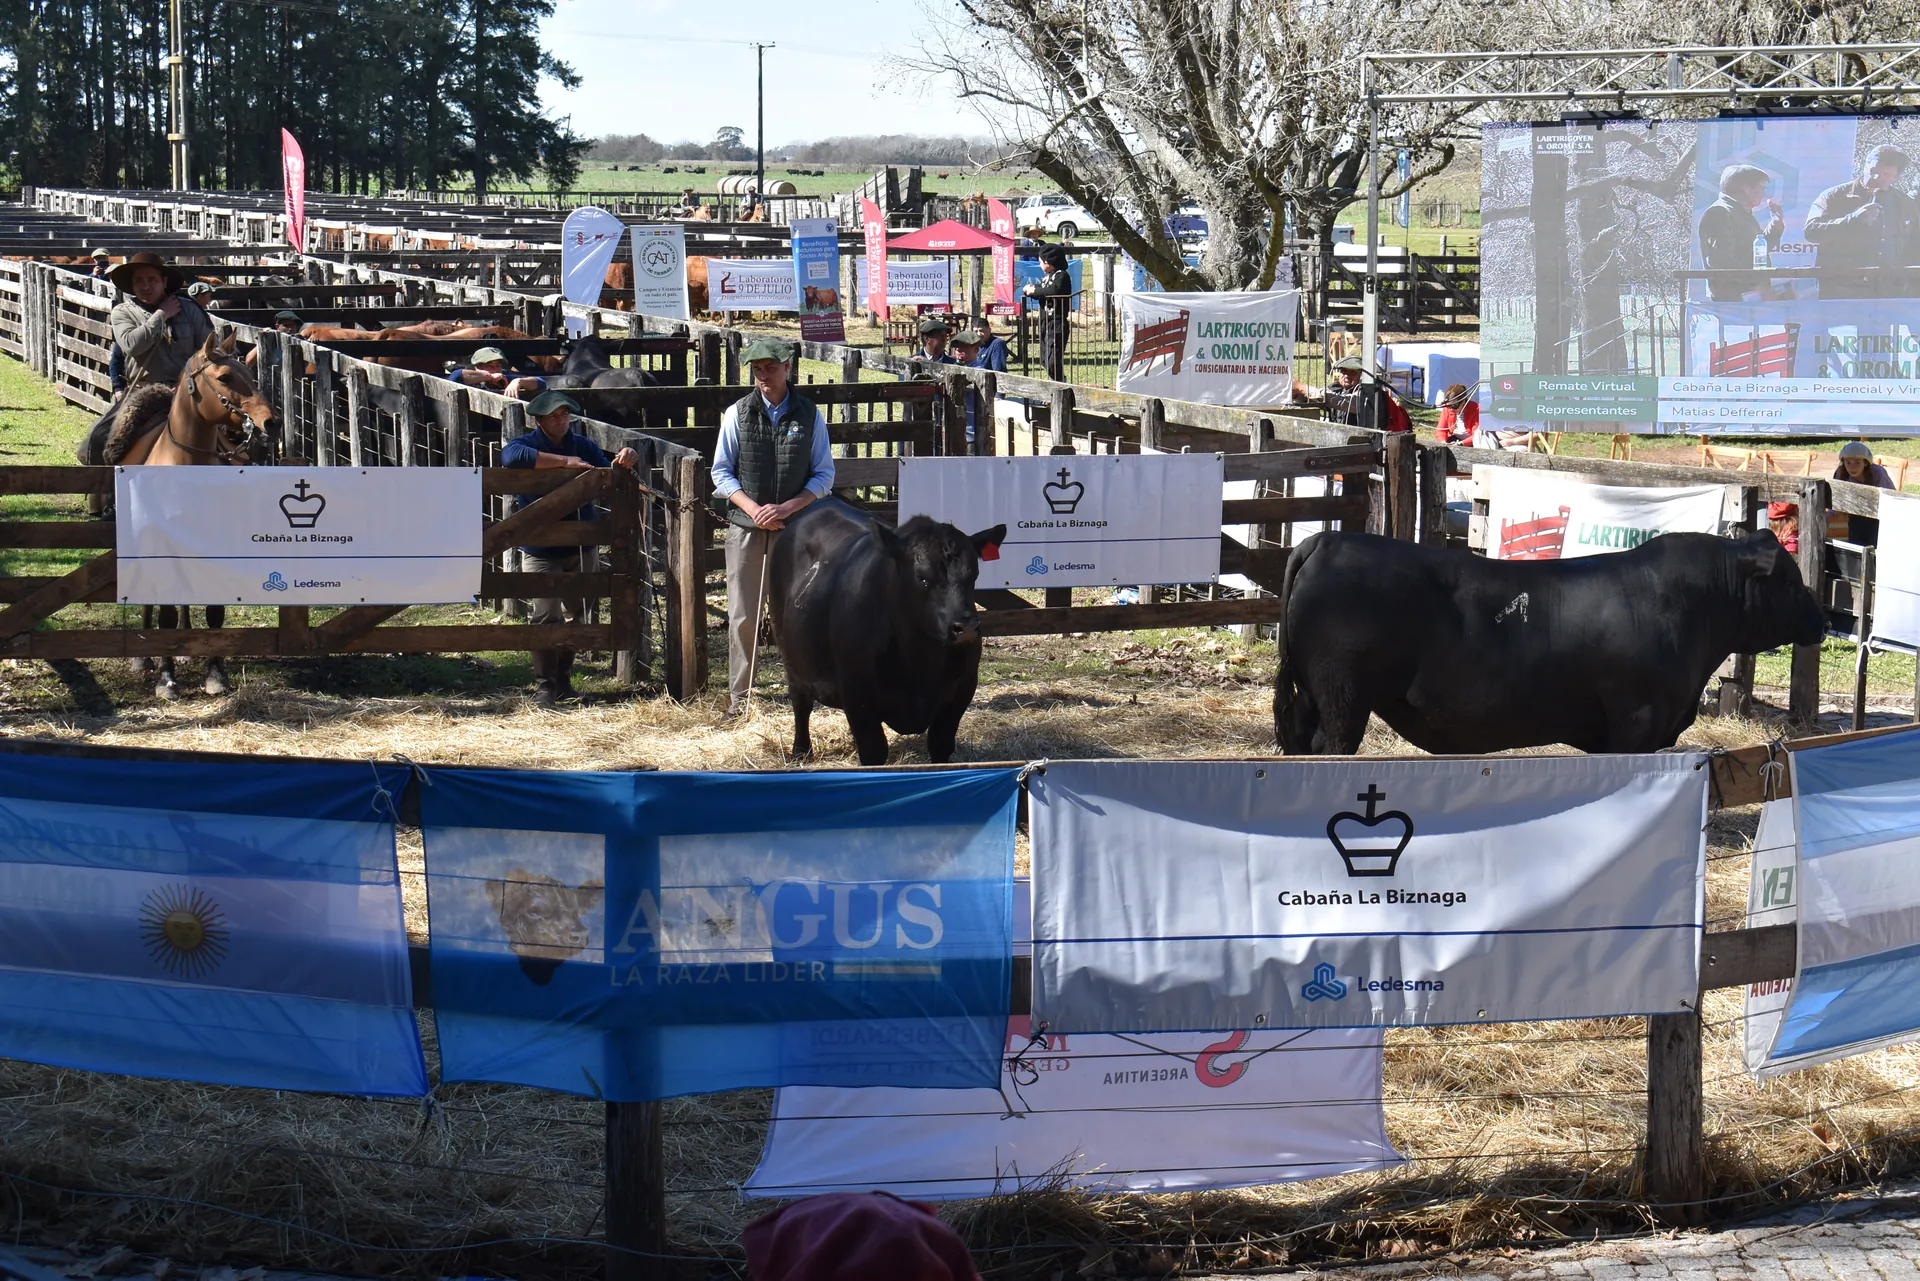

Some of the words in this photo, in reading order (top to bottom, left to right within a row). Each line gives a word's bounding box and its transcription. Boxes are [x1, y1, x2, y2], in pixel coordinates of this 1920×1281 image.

[870, 246, 877, 261] DE
[738, 275, 793, 284] Laboratorio
[870, 263, 878, 294] JULIO
[887, 270, 943, 280] Laboratorio
[738, 284, 744, 294] 9
[746, 284, 760, 293] DE
[762, 284, 792, 294] JULIO
[888, 281, 894, 291] 9
[896, 281, 910, 291] DE
[913, 280, 943, 291] JULIO
[1197, 321, 1290, 339] LARTIRIGOYEN
[1195, 347, 1205, 359] &
[1211, 340, 1261, 360] OROMÍ
[1265, 344, 1289, 361] S.A.
[1814, 335, 1920, 354] LARTIRIG
[1194, 363, 1246, 374] CONSIGNATARIA
[1248, 365, 1257, 374] DE
[1258, 365, 1289, 375] HACIENDA
[1538, 381, 1588, 391] Remate
[1591, 381, 1636, 392] Virtual
[1672, 382, 1722, 393] Cabaña
[1726, 383, 1741, 393] La
[1746, 383, 1799, 396] Biznaga
[1813, 383, 1882, 394] Presencial
[1886, 385, 1893, 396] y
[1536, 405, 1637, 417] Representantes
[1672, 406, 1716, 417] Matias
[1720, 406, 1783, 417] Defferrari
[1017, 520, 1054, 529] Cabaña
[1056, 520, 1067, 528] La
[1069, 519, 1108, 529] Biznaga
[251, 533, 293, 543] Cabaña
[295, 534, 308, 543] La
[310, 534, 353, 545] Biznaga
[1577, 523, 1670, 549] LARTIRI
[1054, 562, 1096, 571] Ledesma
[294, 579, 342, 588] Ledesma
[1278, 889, 1353, 906] Cabaña
[1358, 890, 1381, 904] La
[1386, 888, 1467, 907] Biznaga
[611, 875, 944, 953] ANGUS
[610, 965, 644, 987] LA
[656, 961, 732, 986] RAZA
[1357, 976, 1445, 992] Ledesma
